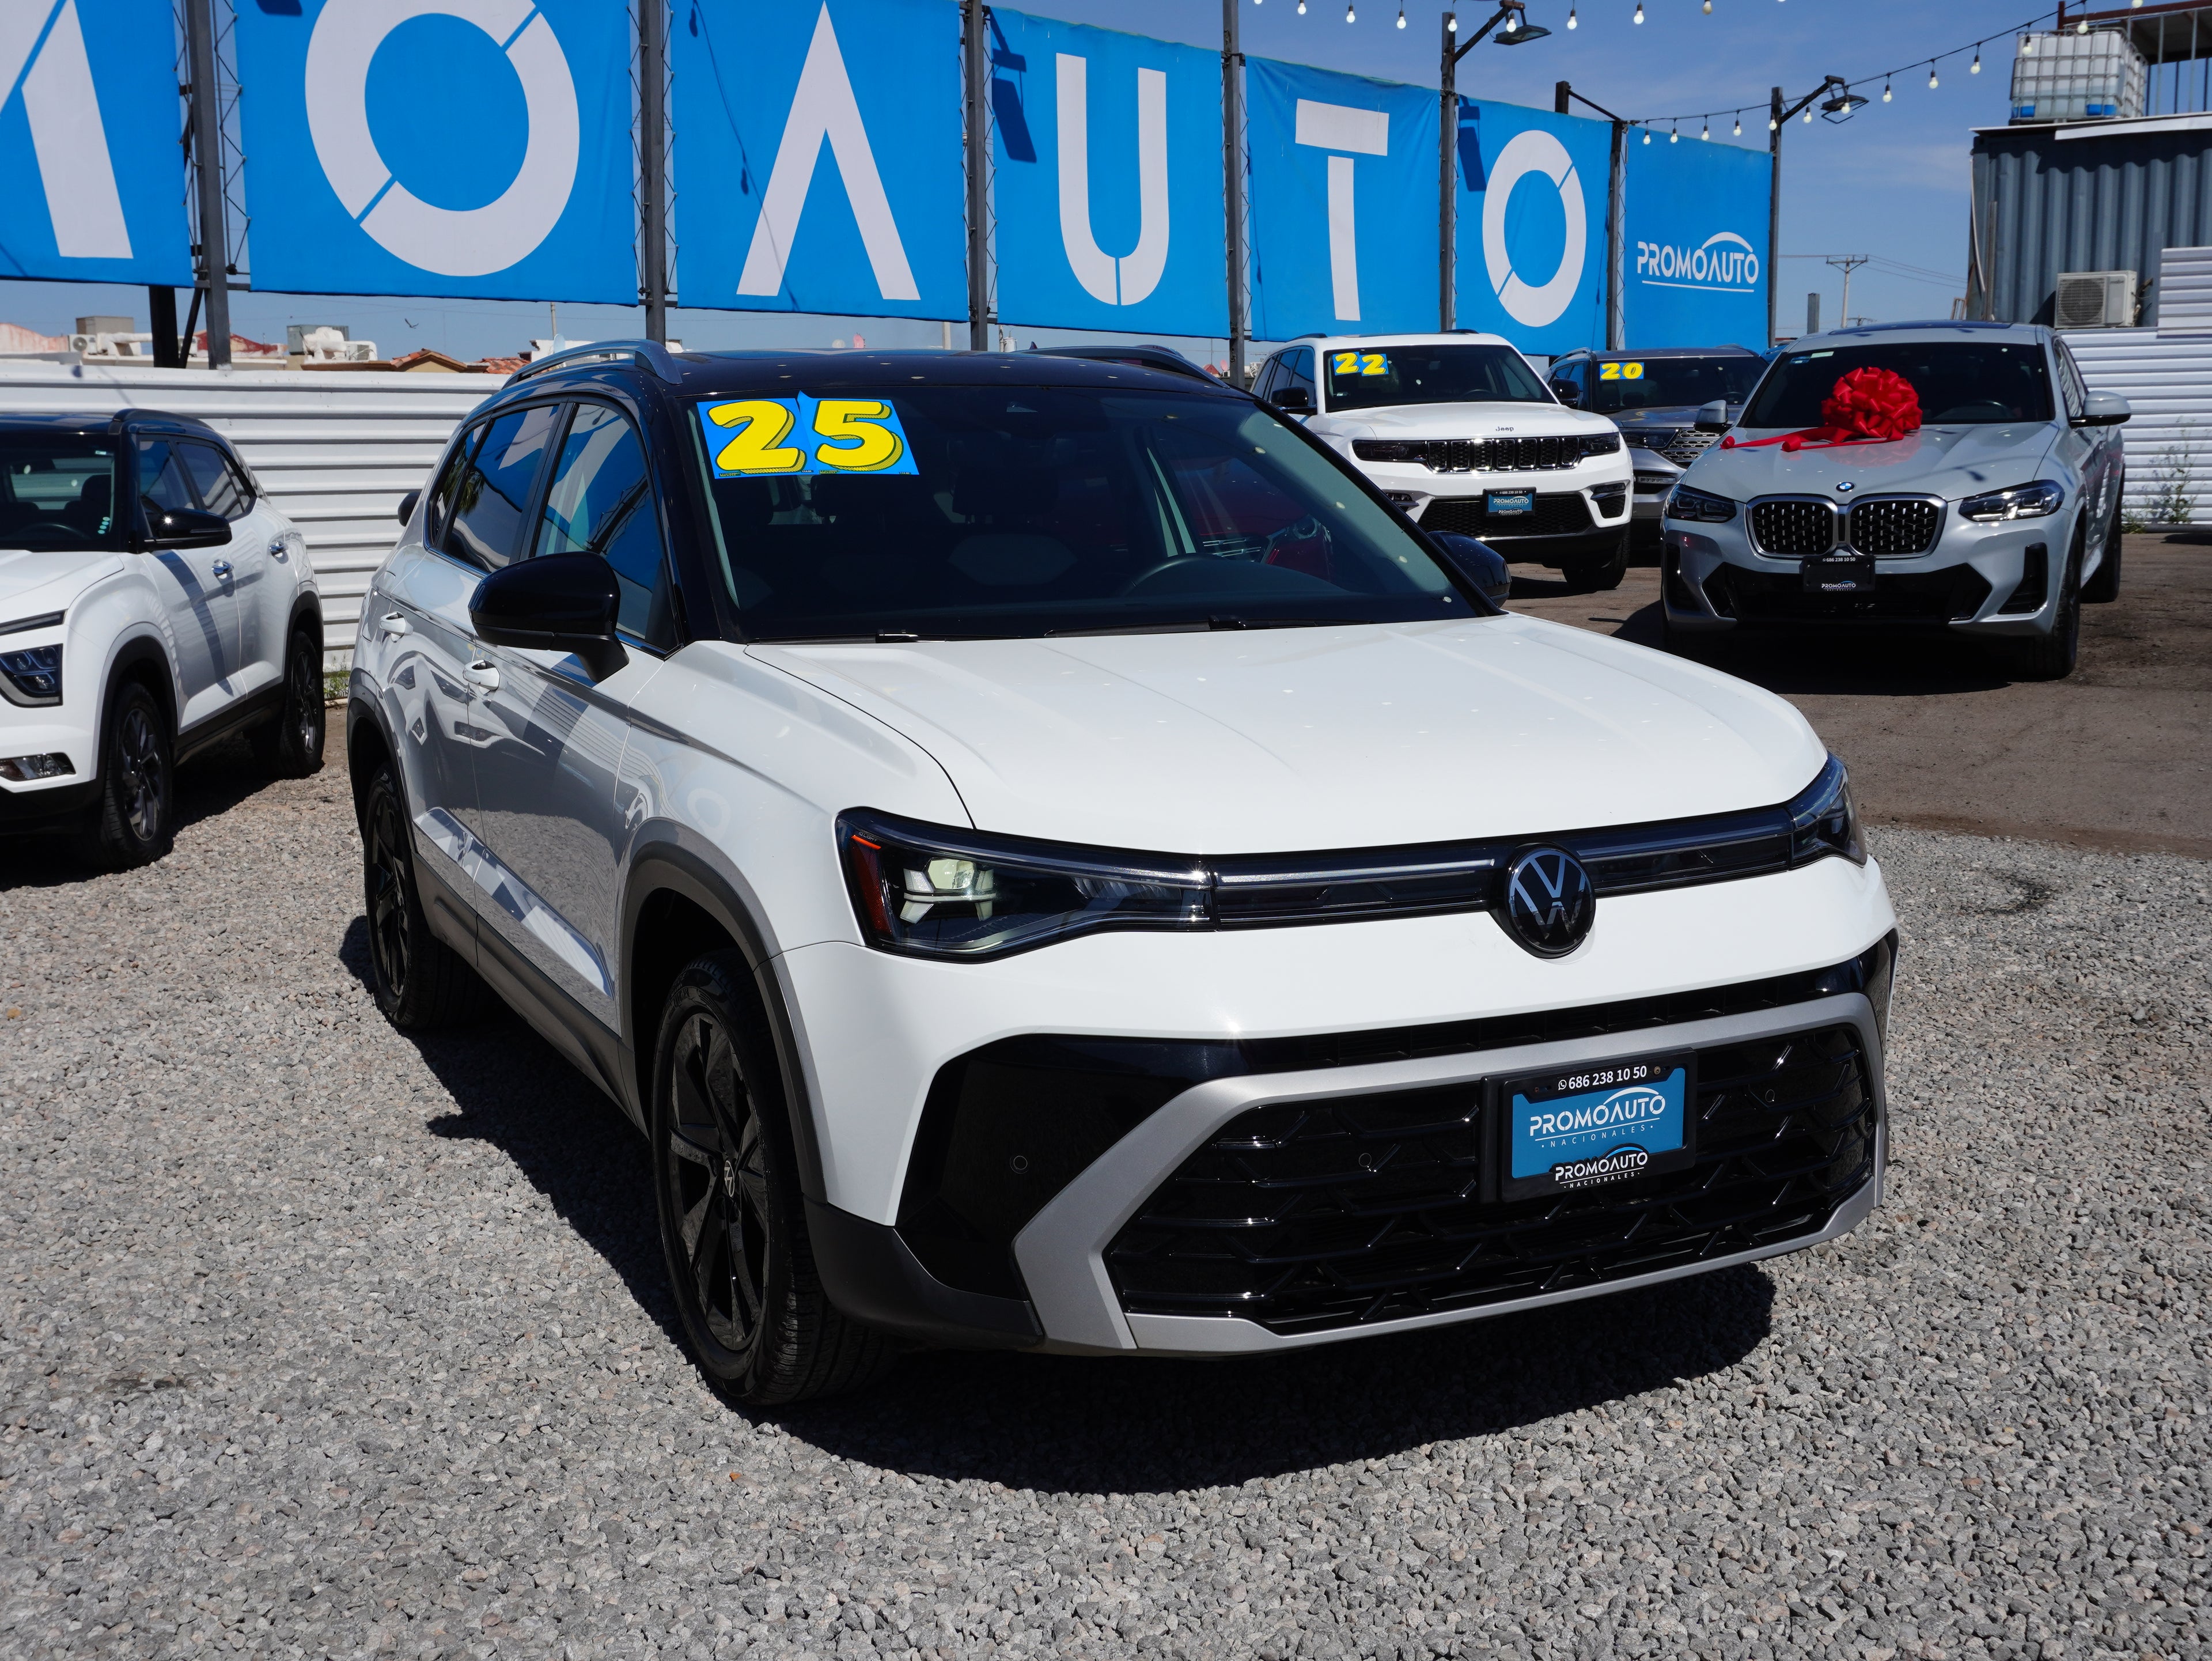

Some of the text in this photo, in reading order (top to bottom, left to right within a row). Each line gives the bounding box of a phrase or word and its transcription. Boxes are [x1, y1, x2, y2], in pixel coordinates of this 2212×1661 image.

[1637, 241, 1759, 284] PROMOAUTO
[1335, 352, 1386, 375] 22
[1600, 362, 1643, 380] 20
[707, 399, 904, 474] 25
[1569, 1065, 1647, 1090] 686 238 10 50
[1529, 1095, 1665, 1137] PROMOAUTO
[1550, 1124, 1646, 1148] NACIONALES
[1555, 1152, 1648, 1181] PROMOAUTO
[1569, 1171, 1635, 1189] NACIONALES
